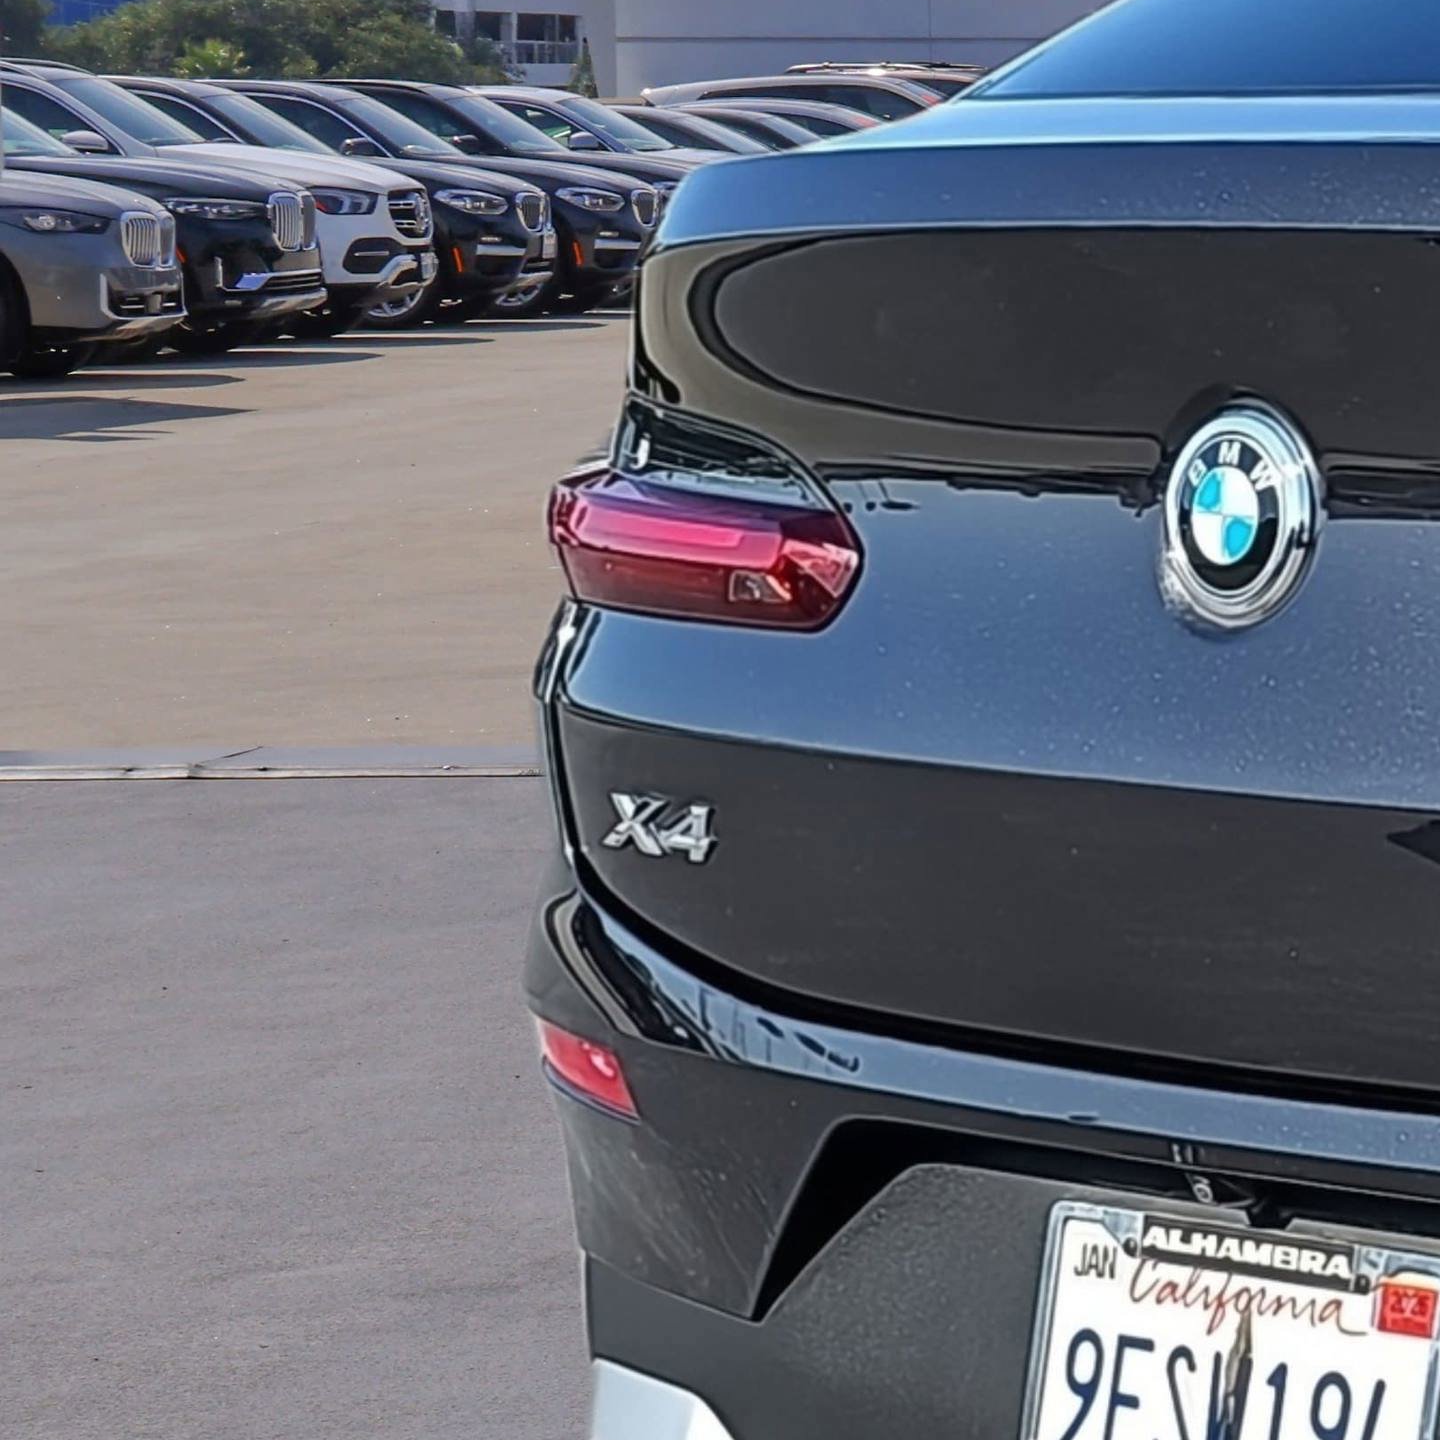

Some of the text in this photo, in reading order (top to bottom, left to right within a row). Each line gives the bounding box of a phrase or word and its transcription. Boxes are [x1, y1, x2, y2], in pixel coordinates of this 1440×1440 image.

[1187, 441, 1275, 491] BMW
[602, 792, 718, 862] X4
[1073, 1243, 1118, 1280] JAN
[1142, 1225, 1353, 1280] ALHAMBRA
[1129, 1257, 1369, 1337] California
